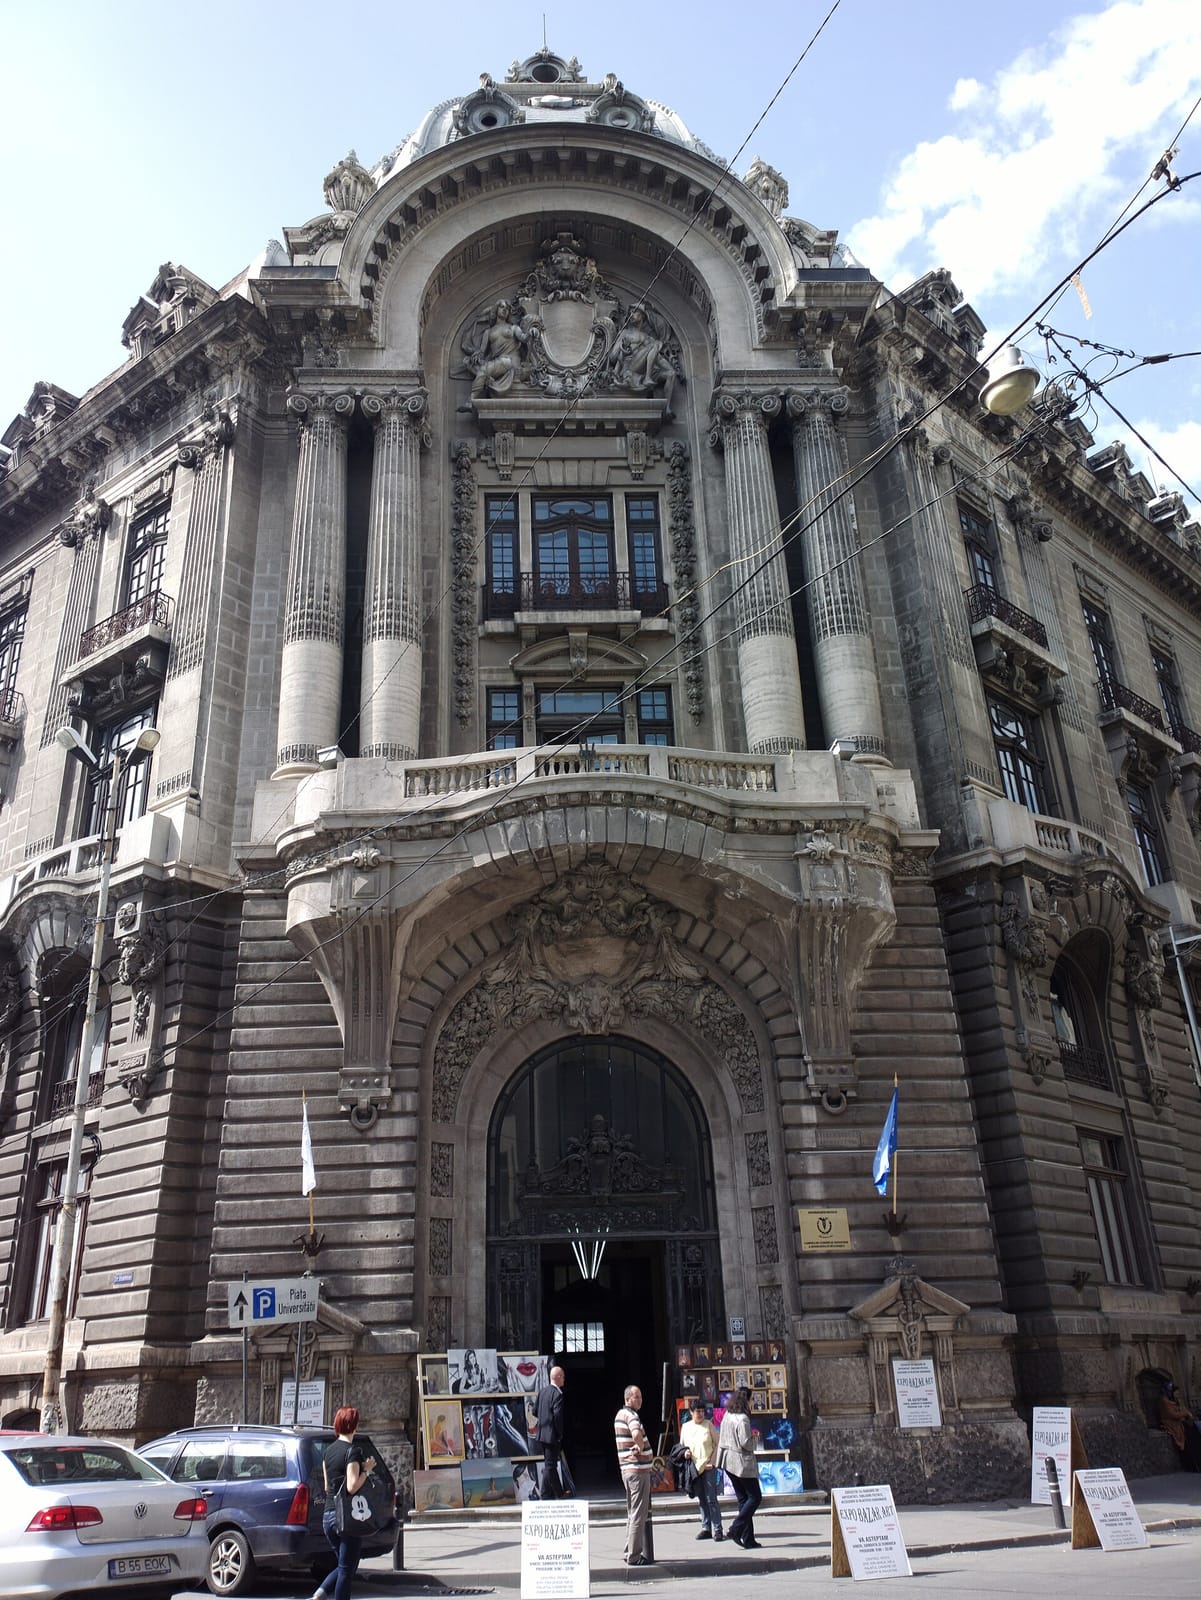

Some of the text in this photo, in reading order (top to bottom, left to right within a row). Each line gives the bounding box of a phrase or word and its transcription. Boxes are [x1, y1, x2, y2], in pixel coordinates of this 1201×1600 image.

[260, 1296, 271, 1317] P
[840, 1505, 894, 1523] EXPO BAZAR ART
[524, 1522, 586, 1540] EXPO BAZAR ART
[118, 1558, 166, 1573] B 55 EOK
